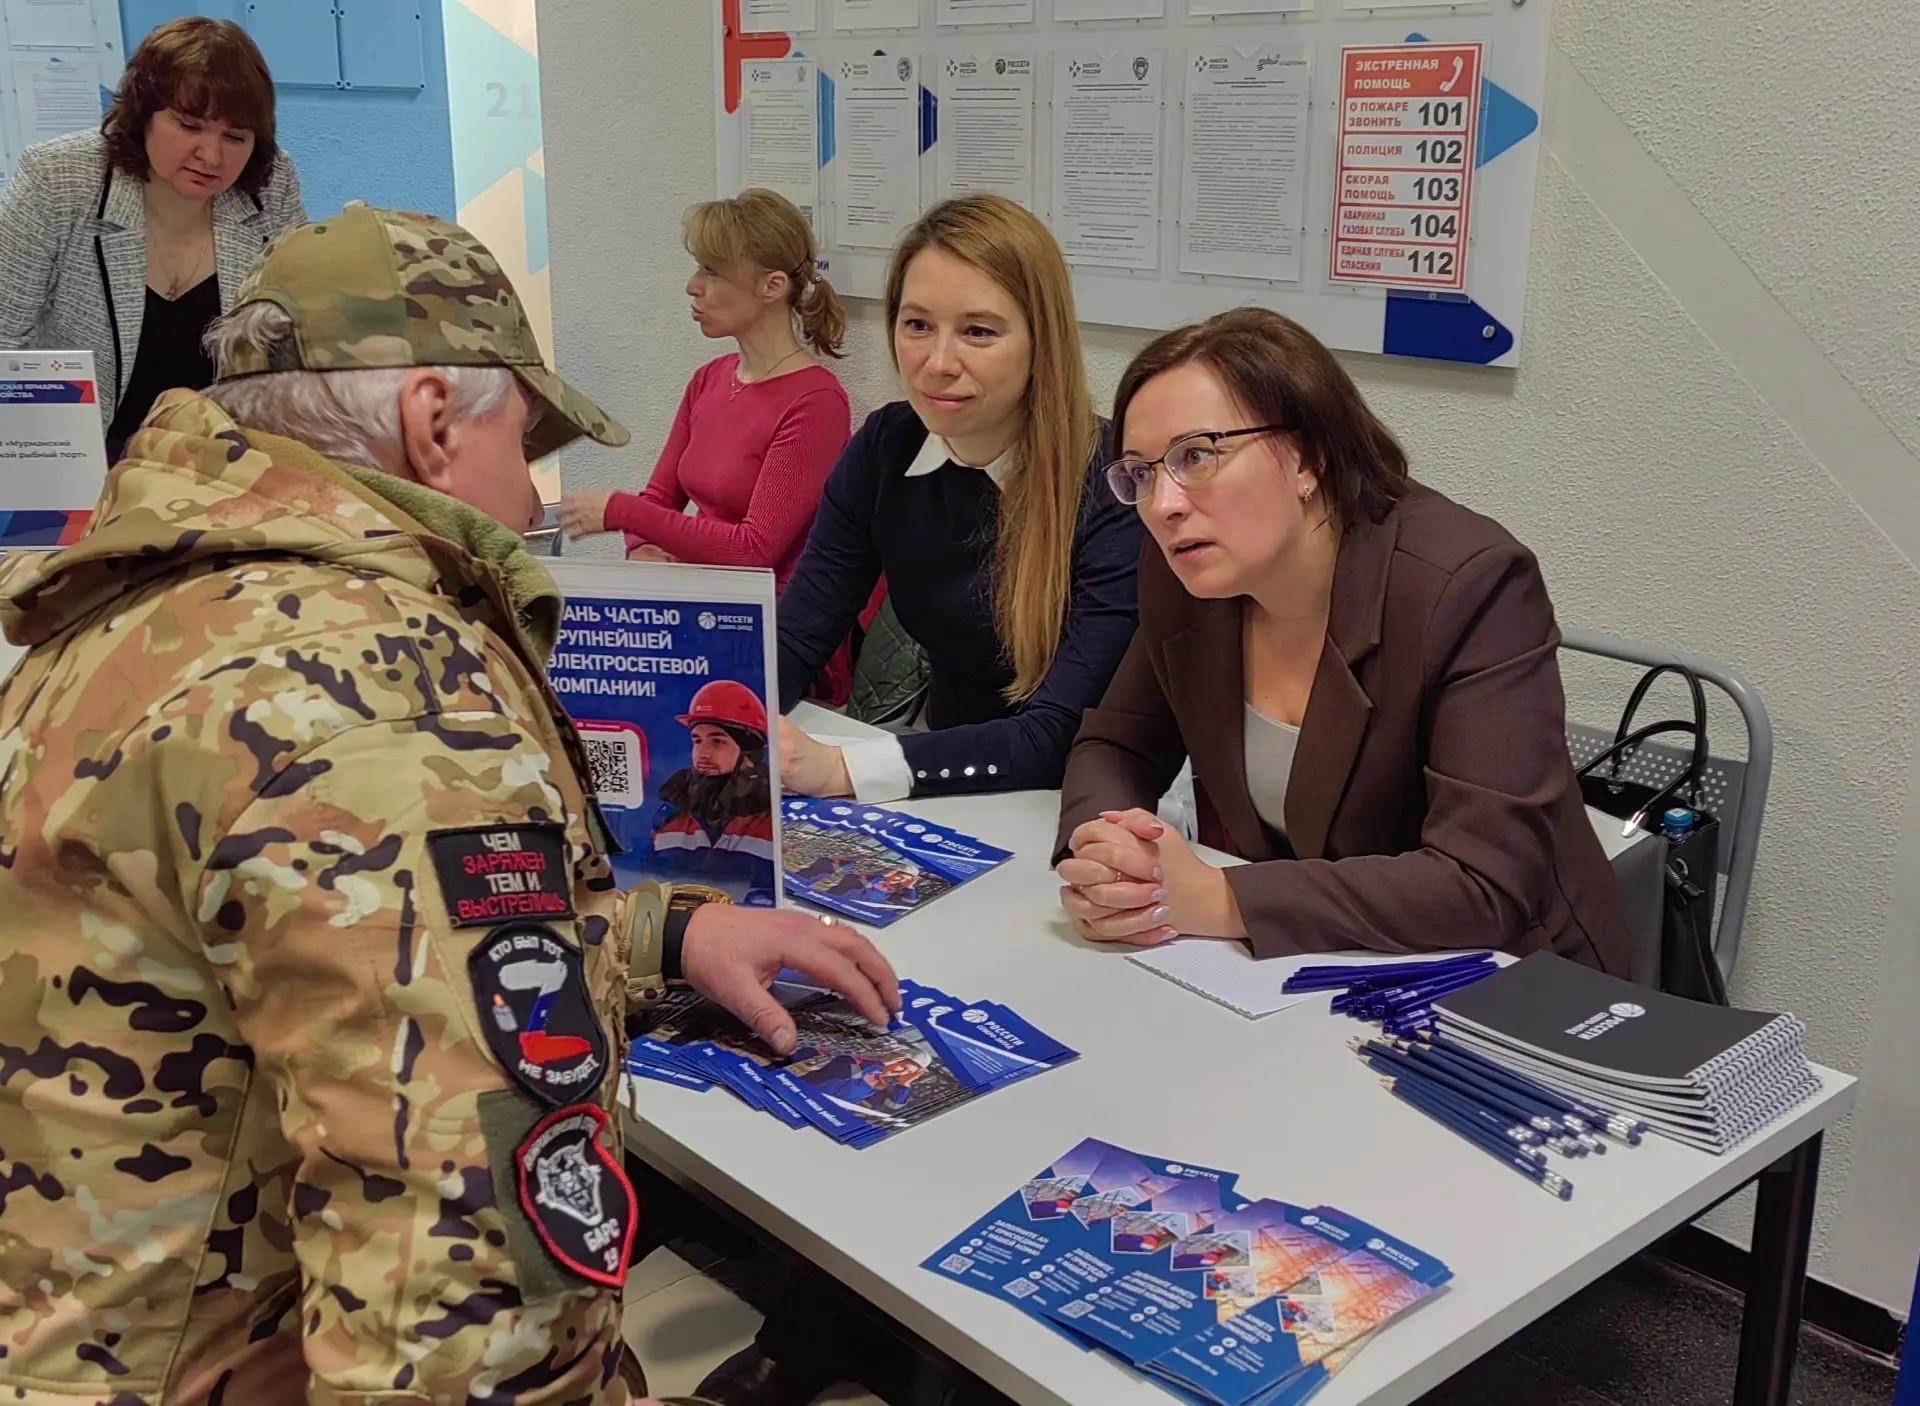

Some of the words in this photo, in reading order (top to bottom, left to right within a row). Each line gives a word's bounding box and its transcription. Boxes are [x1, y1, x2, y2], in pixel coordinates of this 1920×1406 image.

[1355, 59, 1439, 72] ЭКСТРЕННАЯ
[1354, 78, 1411, 90] ПОМОЩЬ
[486, 82, 536, 119] 21
[1349, 102, 1357, 113] О
[1360, 101, 1409, 113] ПОЖАРЕ
[1349, 116, 1402, 128] ЗВОНИТЬ
[1418, 102, 1463, 127] 101
[1347, 145, 1403, 157] ПОЛИЦИЯ
[1415, 139, 1463, 164] 102
[1345, 174, 1390, 186] СКОРАЯ
[1413, 177, 1460, 202] 103
[1344, 189, 1396, 201] ПОМОЩЬ
[1343, 210, 1386, 221] АВАРИЙНАЯ
[1342, 225, 1374, 236] ГАЗОВАЯ
[1375, 226, 1405, 237] СЛУЖБА
[1410, 214, 1457, 239] 104
[1341, 245, 1372, 256] ЕДИНАЯ
[1374, 247, 1405, 258] СЛУЖБА
[1340, 260, 1382, 271] СПАСЕНИЯ
[1407, 250, 1454, 275] 112
[0, 391, 34, 399] ОЙСТВА
[563, 605, 601, 622] АНЬ
[604, 606, 681, 625] ЧАСТЬЮ
[717, 615, 753, 624] РОССЕТИ
[557, 629, 673, 650] РУПНЕЙШЕЙ
[546, 652, 709, 676] ЭЛЕКТРОСЕТЕВОЙ
[549, 676, 657, 697] КОМПАНИИ!
[481, 832, 523, 852] ЧЕМ
[462, 852, 546, 874] ЗАРЯЖЕН
[484, 873, 524, 894] ТЕМ
[525, 872, 541, 891] И
[488, 940, 512, 962] КТО
[512, 936, 539, 950] БЫЛ
[984, 1020, 1025, 1046] РОССЕТИ
[1577, 1015, 1626, 1041] РОССЕТИ
[518, 1059, 543, 1079] НЕ
[545, 1053, 601, 1085] ЗАБУДЕТ
[583, 1218, 620, 1252] БАРС
